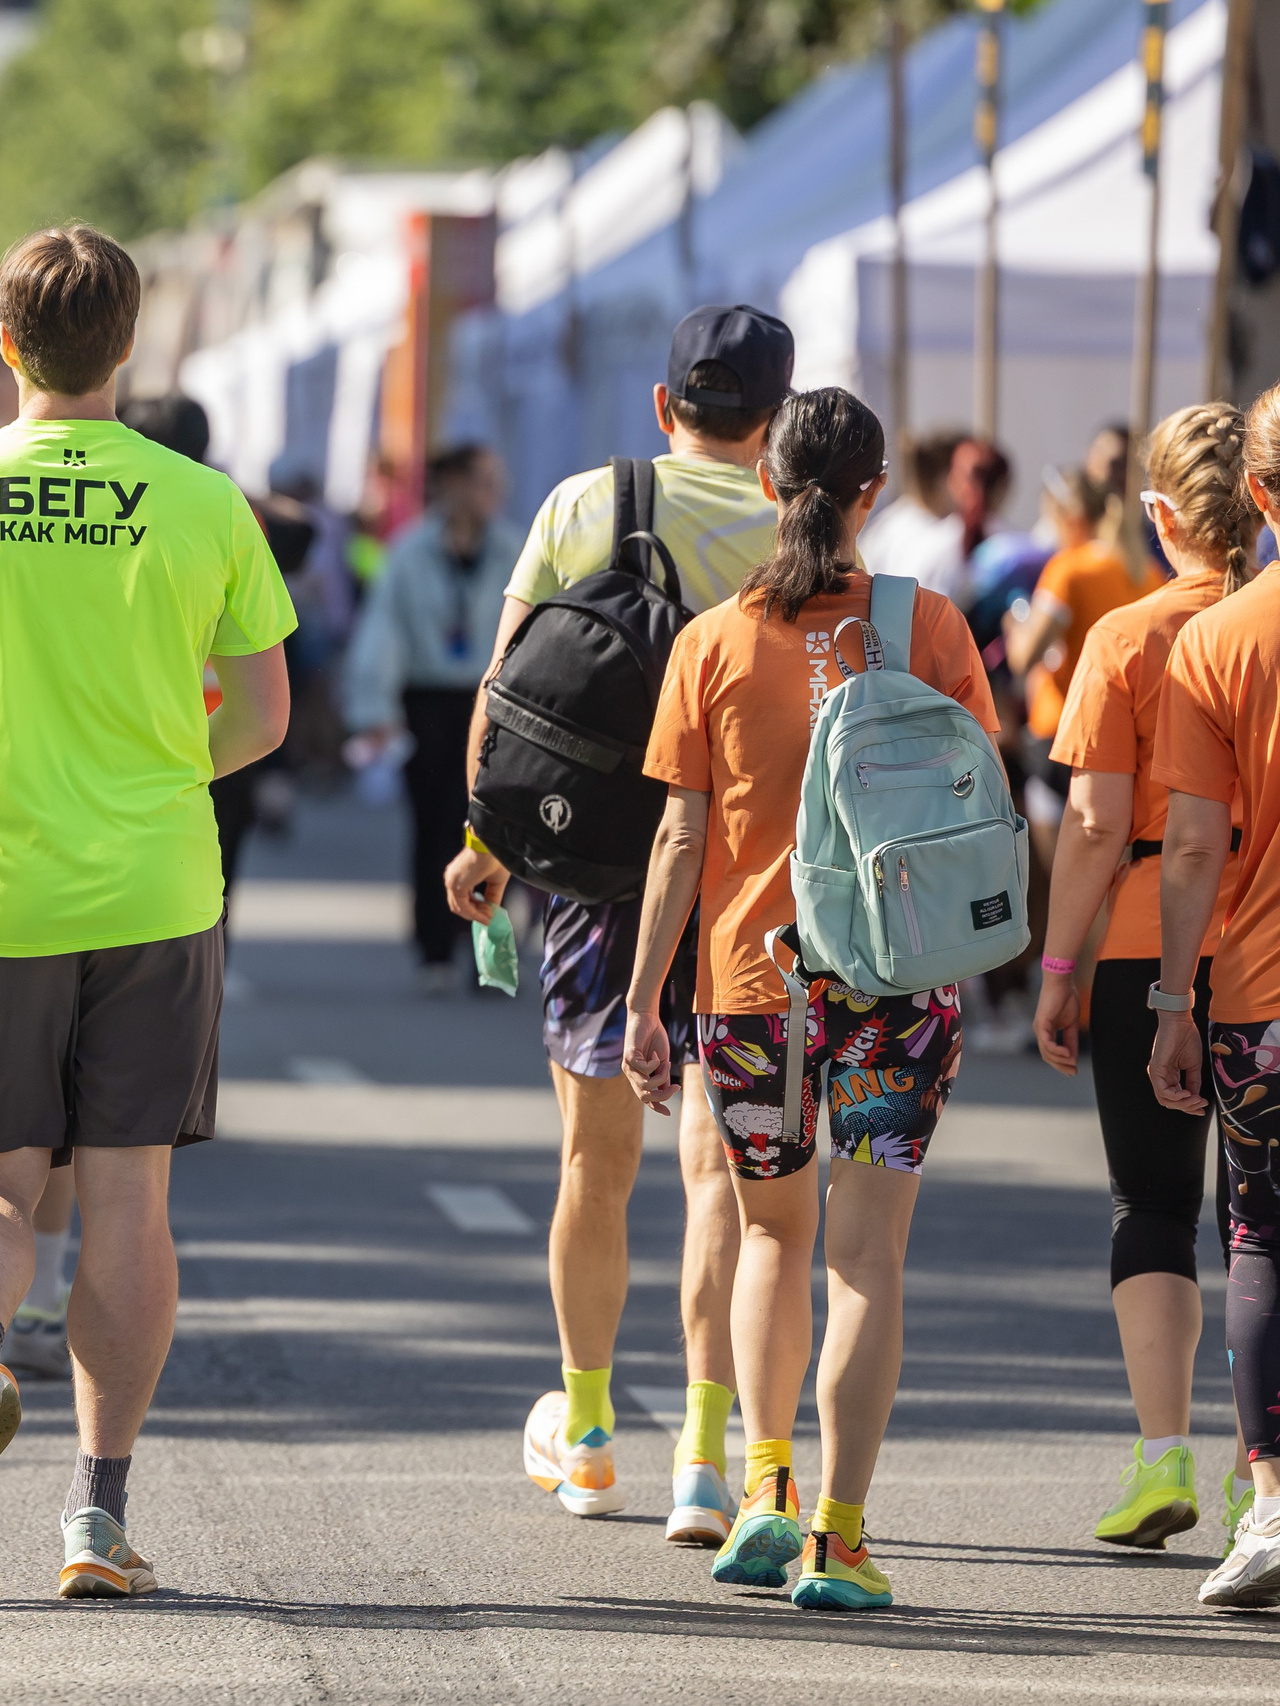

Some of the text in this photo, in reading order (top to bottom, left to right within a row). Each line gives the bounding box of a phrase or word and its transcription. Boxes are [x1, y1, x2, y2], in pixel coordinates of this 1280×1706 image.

[0, 476, 149, 520] БЕГУ
[0, 520, 147, 546] КАК МОГУ
[809, 659, 828, 738] MAX
[713, 1069, 741, 1087] OUCH
[829, 1066, 915, 1119] ANG
